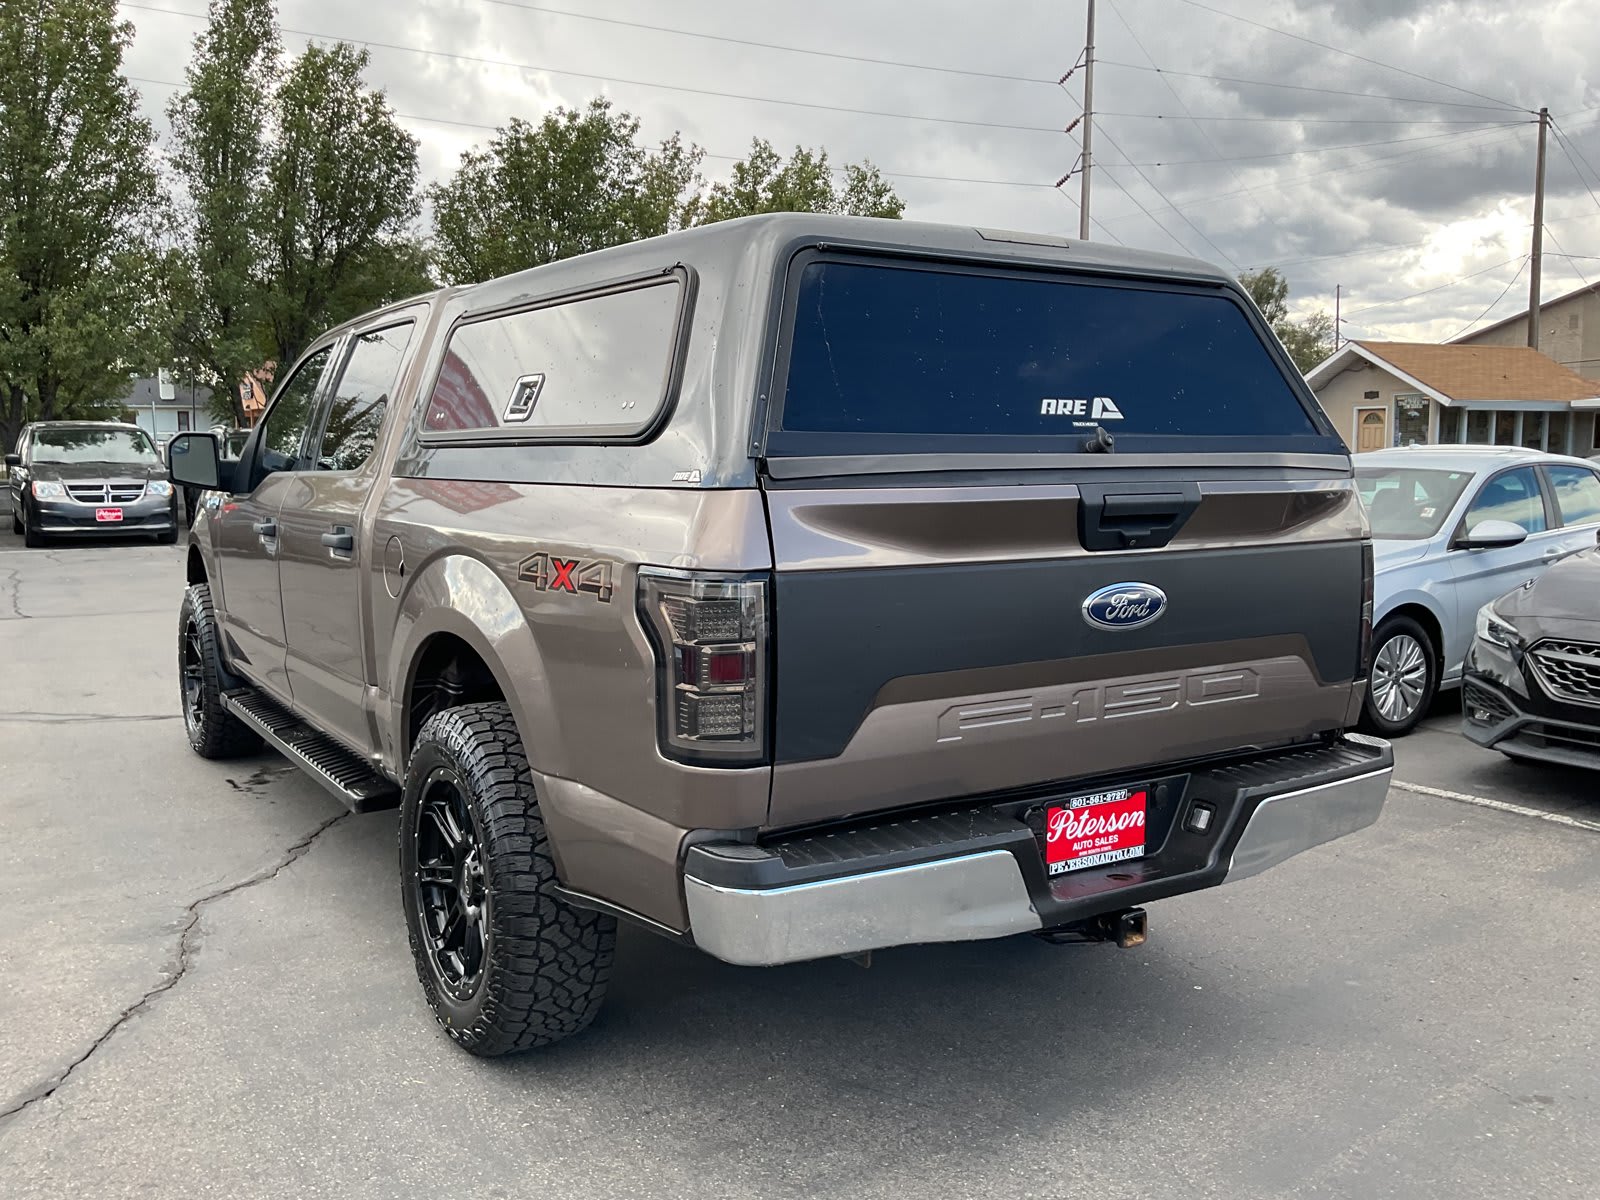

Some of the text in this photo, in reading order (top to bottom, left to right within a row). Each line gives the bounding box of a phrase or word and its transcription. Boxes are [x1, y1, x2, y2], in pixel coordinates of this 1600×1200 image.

[1041, 398, 1087, 415] ARE
[1105, 593, 1152, 620] Ford
[936, 667, 1260, 743] F-150
[1047, 809, 1145, 842] Peterson
[1072, 834, 1119, 851] AUTO SALES
